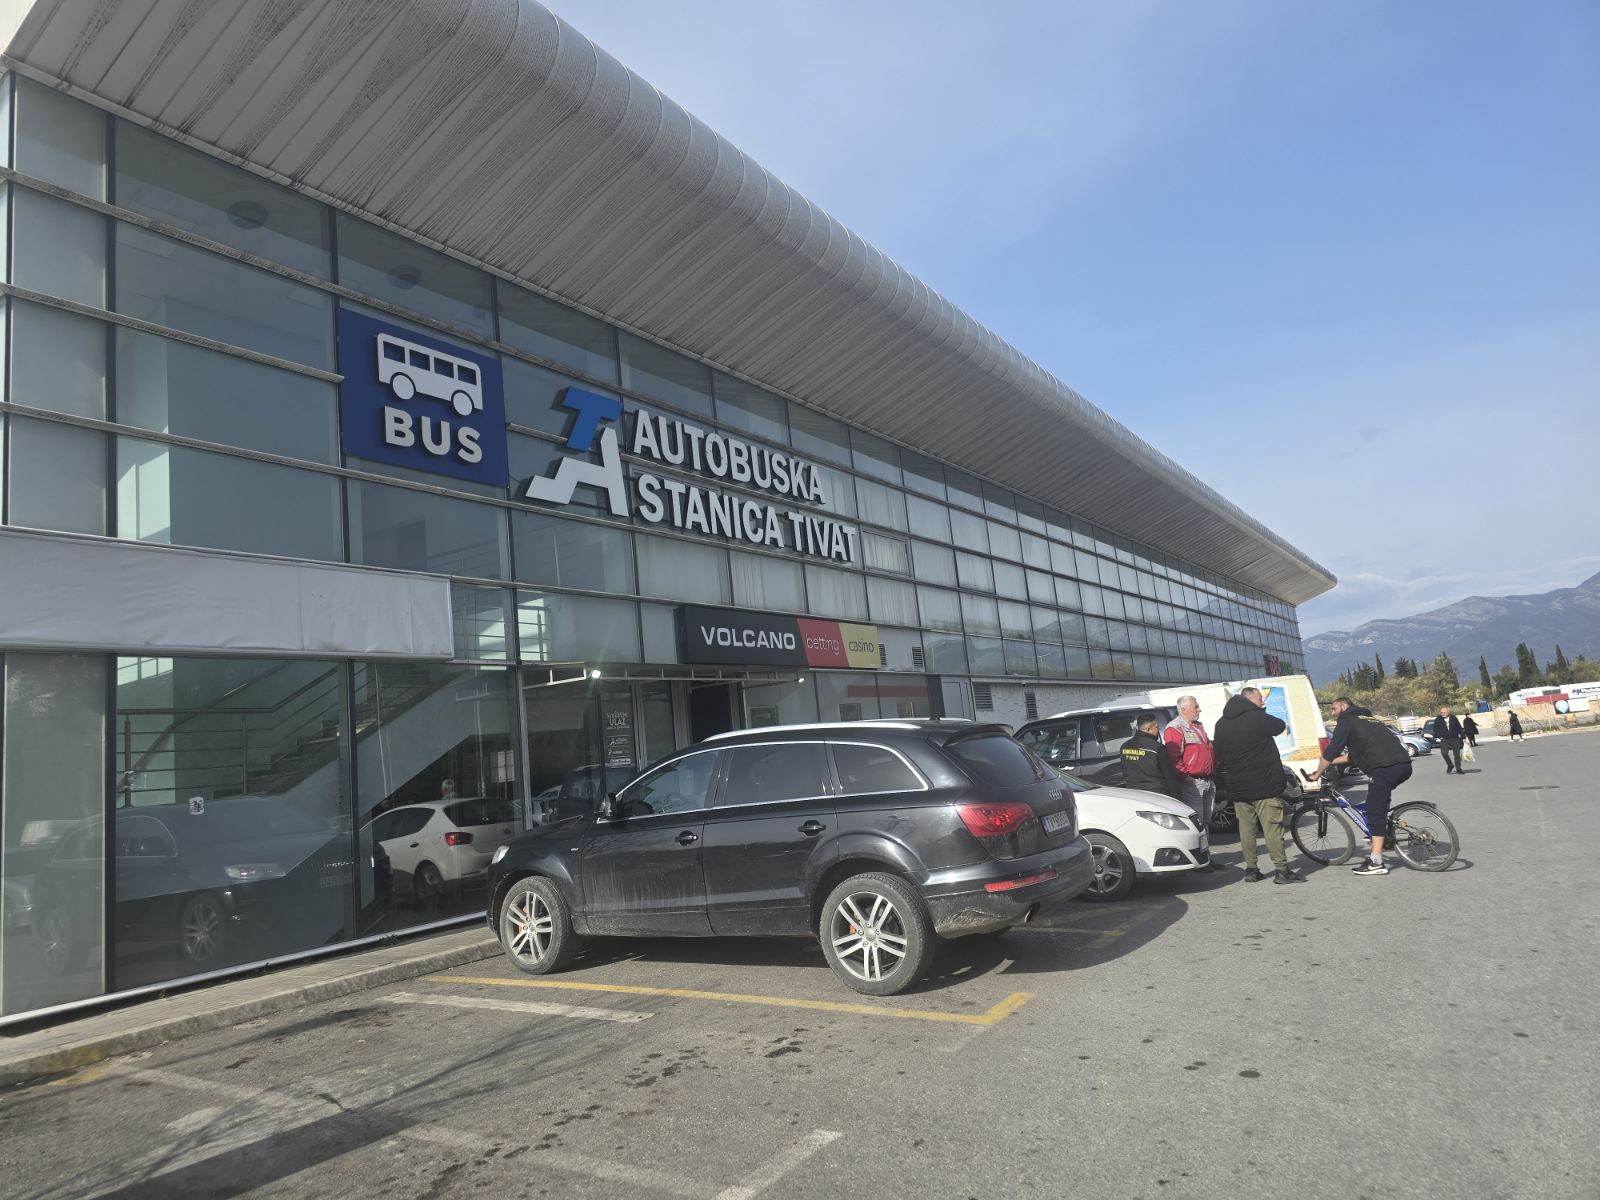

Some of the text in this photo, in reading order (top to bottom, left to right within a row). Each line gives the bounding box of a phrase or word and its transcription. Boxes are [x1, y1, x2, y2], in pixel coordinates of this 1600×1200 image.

[384, 405, 484, 464] BUS
[633, 409, 824, 504] AUTOBUSKA
[639, 474, 856, 562] STANICA TIVAT
[700, 625, 874, 655] VOLCANO betting casino
